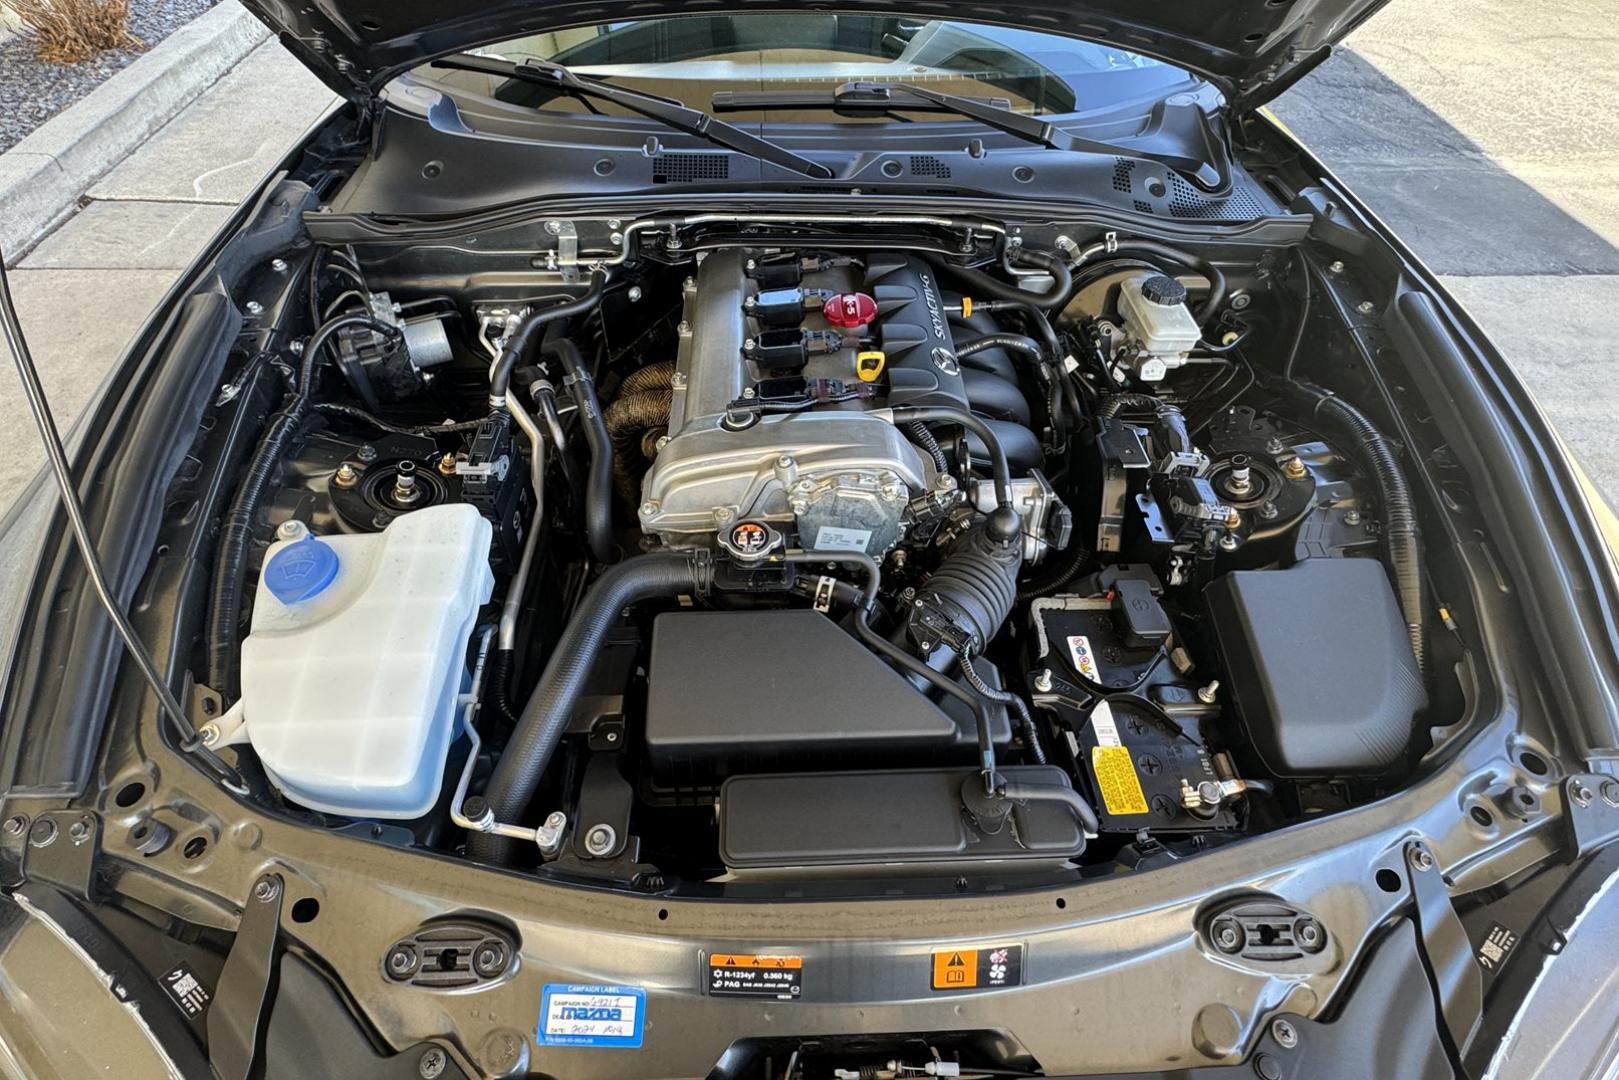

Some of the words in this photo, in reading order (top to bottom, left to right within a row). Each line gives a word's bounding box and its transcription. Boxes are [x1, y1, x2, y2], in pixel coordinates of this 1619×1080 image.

[919, 273, 945, 340] SKYACTIV-G
[723, 971, 755, 980] R-1234yf
[783, 973, 793, 981] kg
[724, 980, 740, 988] PAG
[567, 985, 599, 993] CAMPAIGN
[600, 986, 621, 994] LABEL
[560, 1006, 622, 1021] mazda
